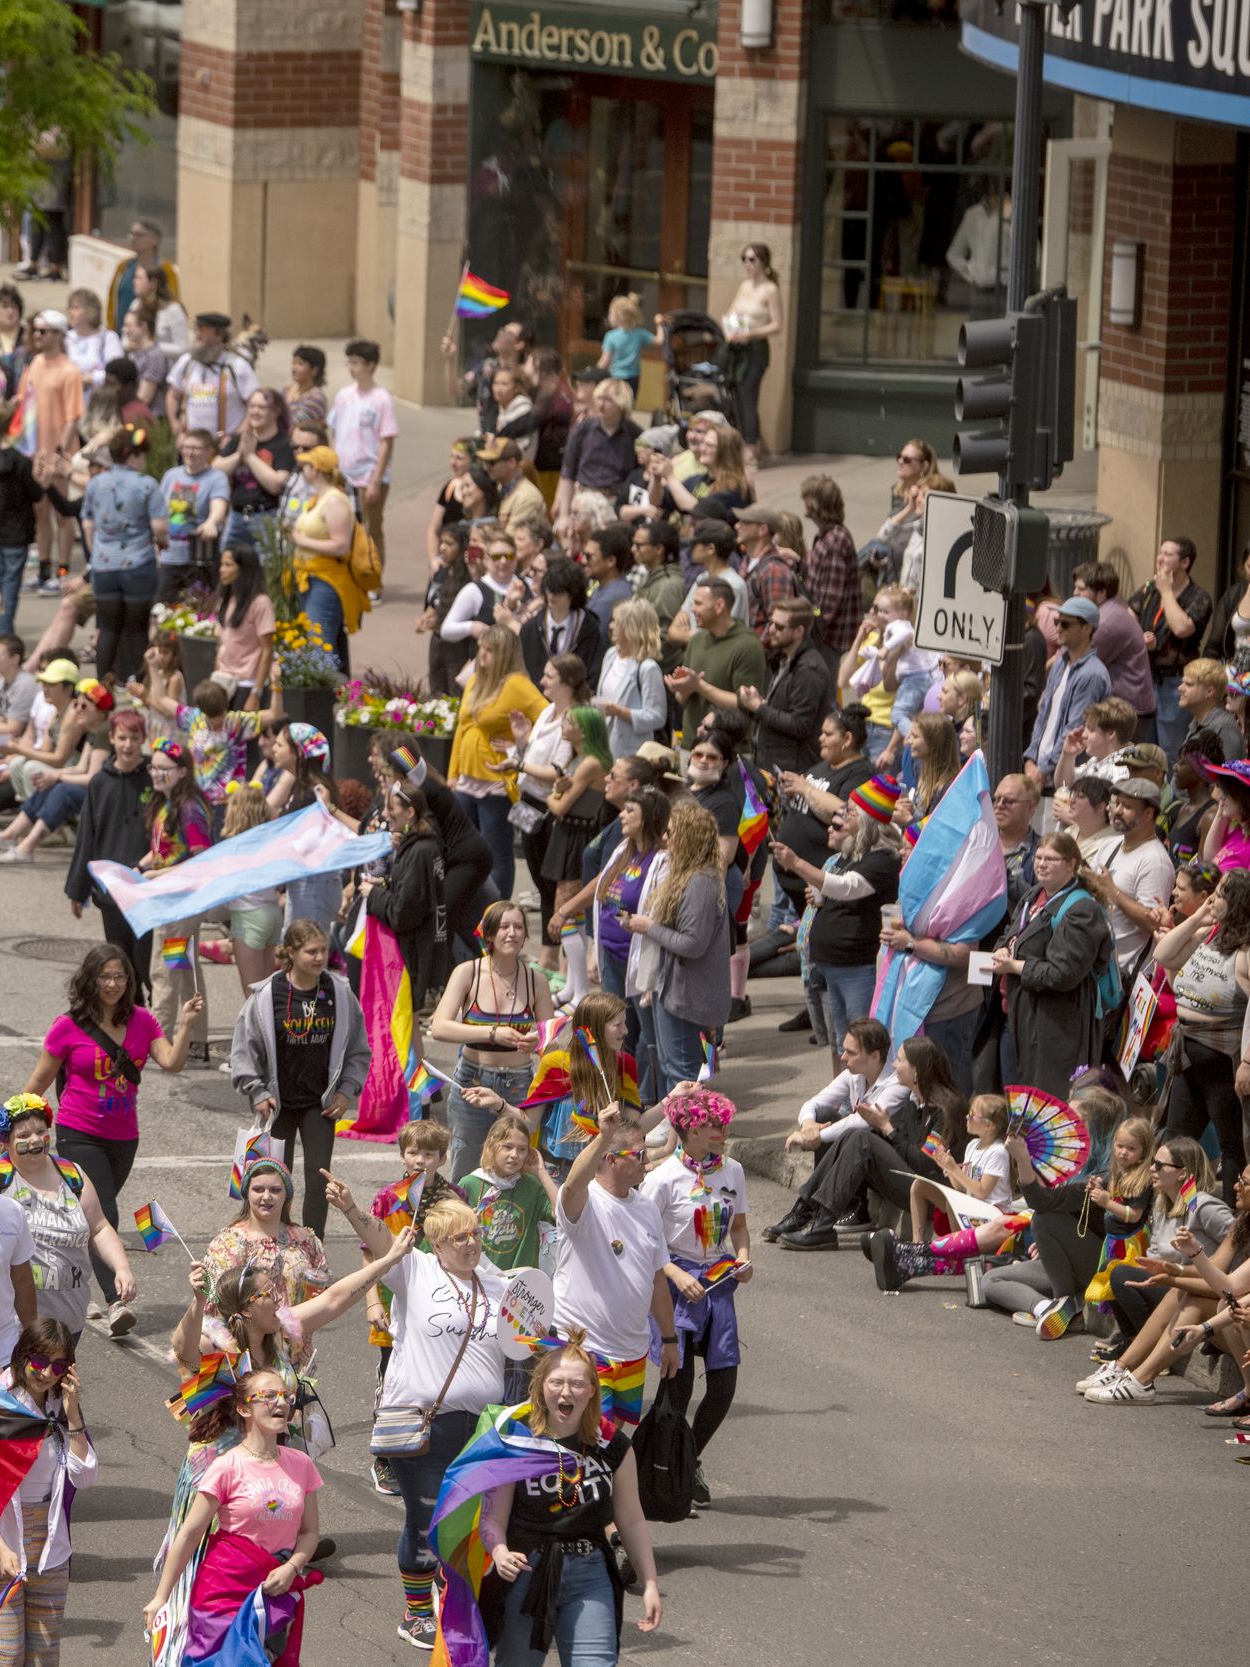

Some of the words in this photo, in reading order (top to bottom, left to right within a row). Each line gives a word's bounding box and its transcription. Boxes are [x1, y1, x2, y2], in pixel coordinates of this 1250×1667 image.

[471, 9, 633, 68] Anderson
[640, 25, 666, 71] &
[1093, 0, 1175, 62] PARK
[934, 608, 995, 649] ONLY
[511, 1280, 546, 1316] stronger
